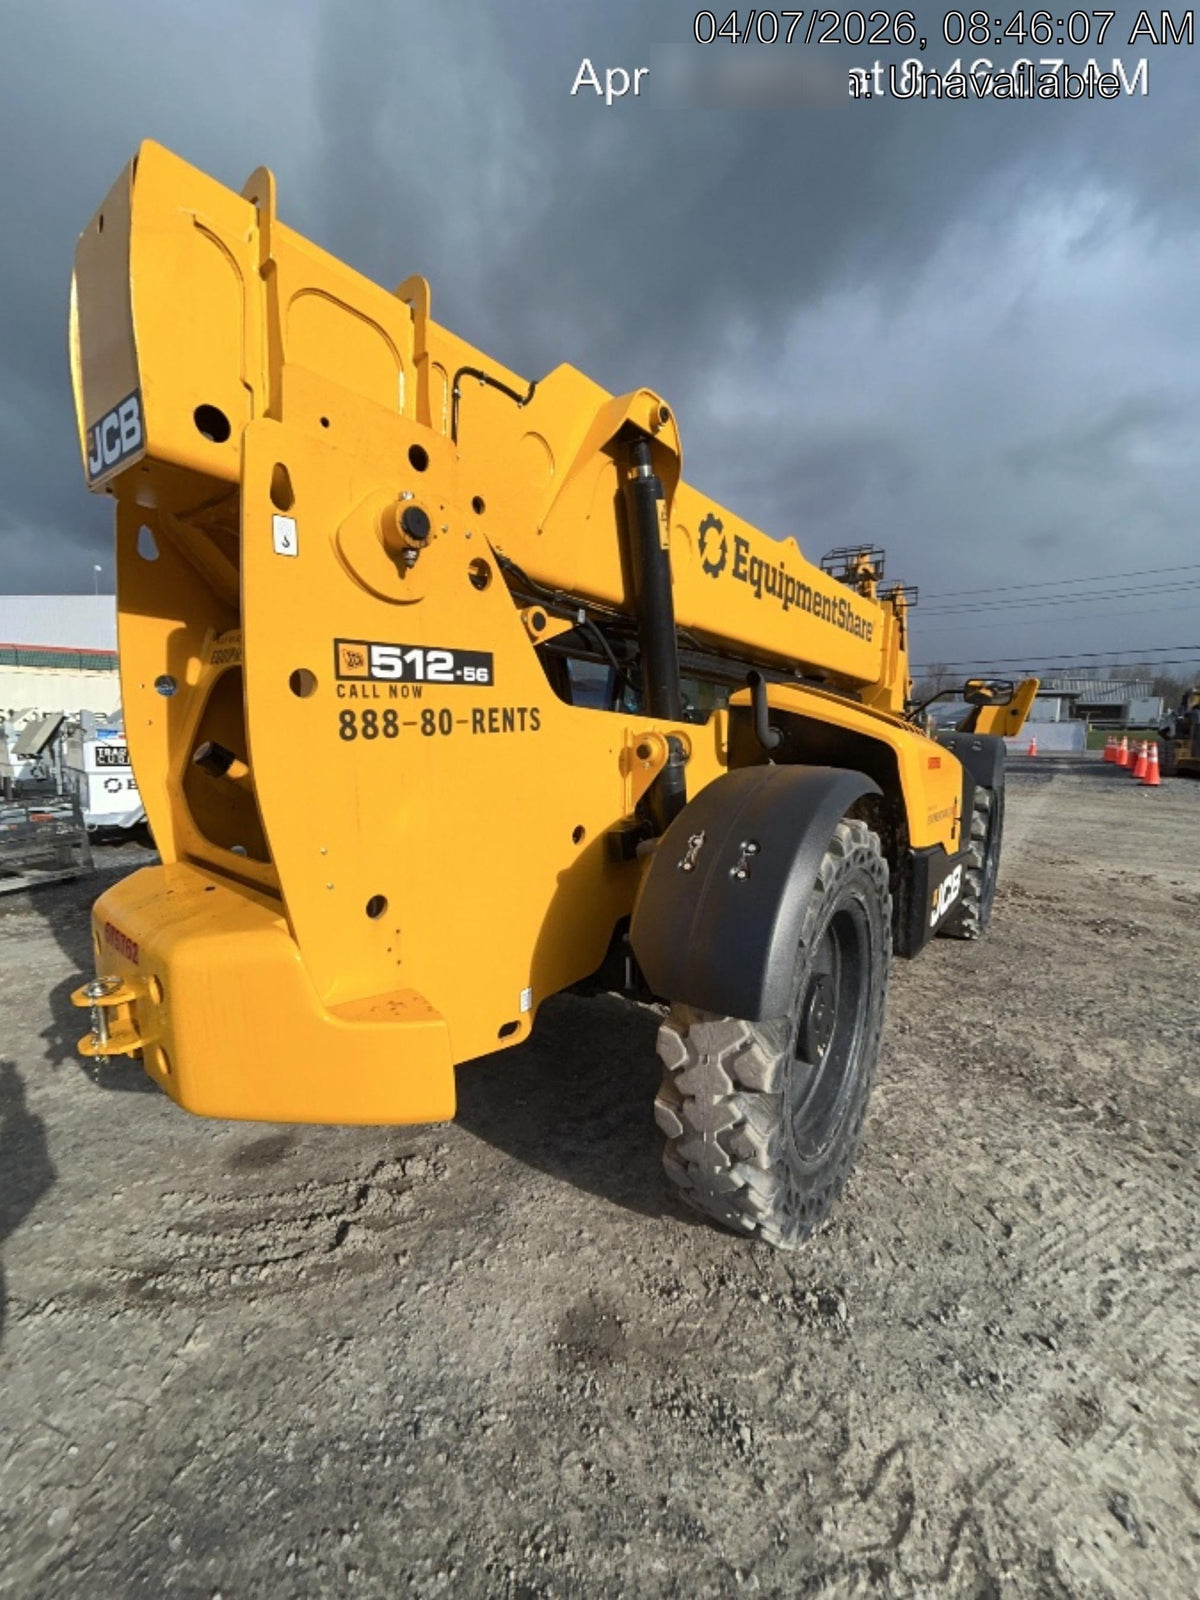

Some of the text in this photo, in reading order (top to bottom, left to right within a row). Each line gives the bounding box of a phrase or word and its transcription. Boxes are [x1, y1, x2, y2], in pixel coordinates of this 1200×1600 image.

[89, 396, 141, 475] JCB
[732, 534, 873, 643] EquipmentShare
[336, 683, 423, 699] CALL NOW
[338, 706, 541, 742] 888-80-RENTS
[930, 863, 963, 928] JCB
